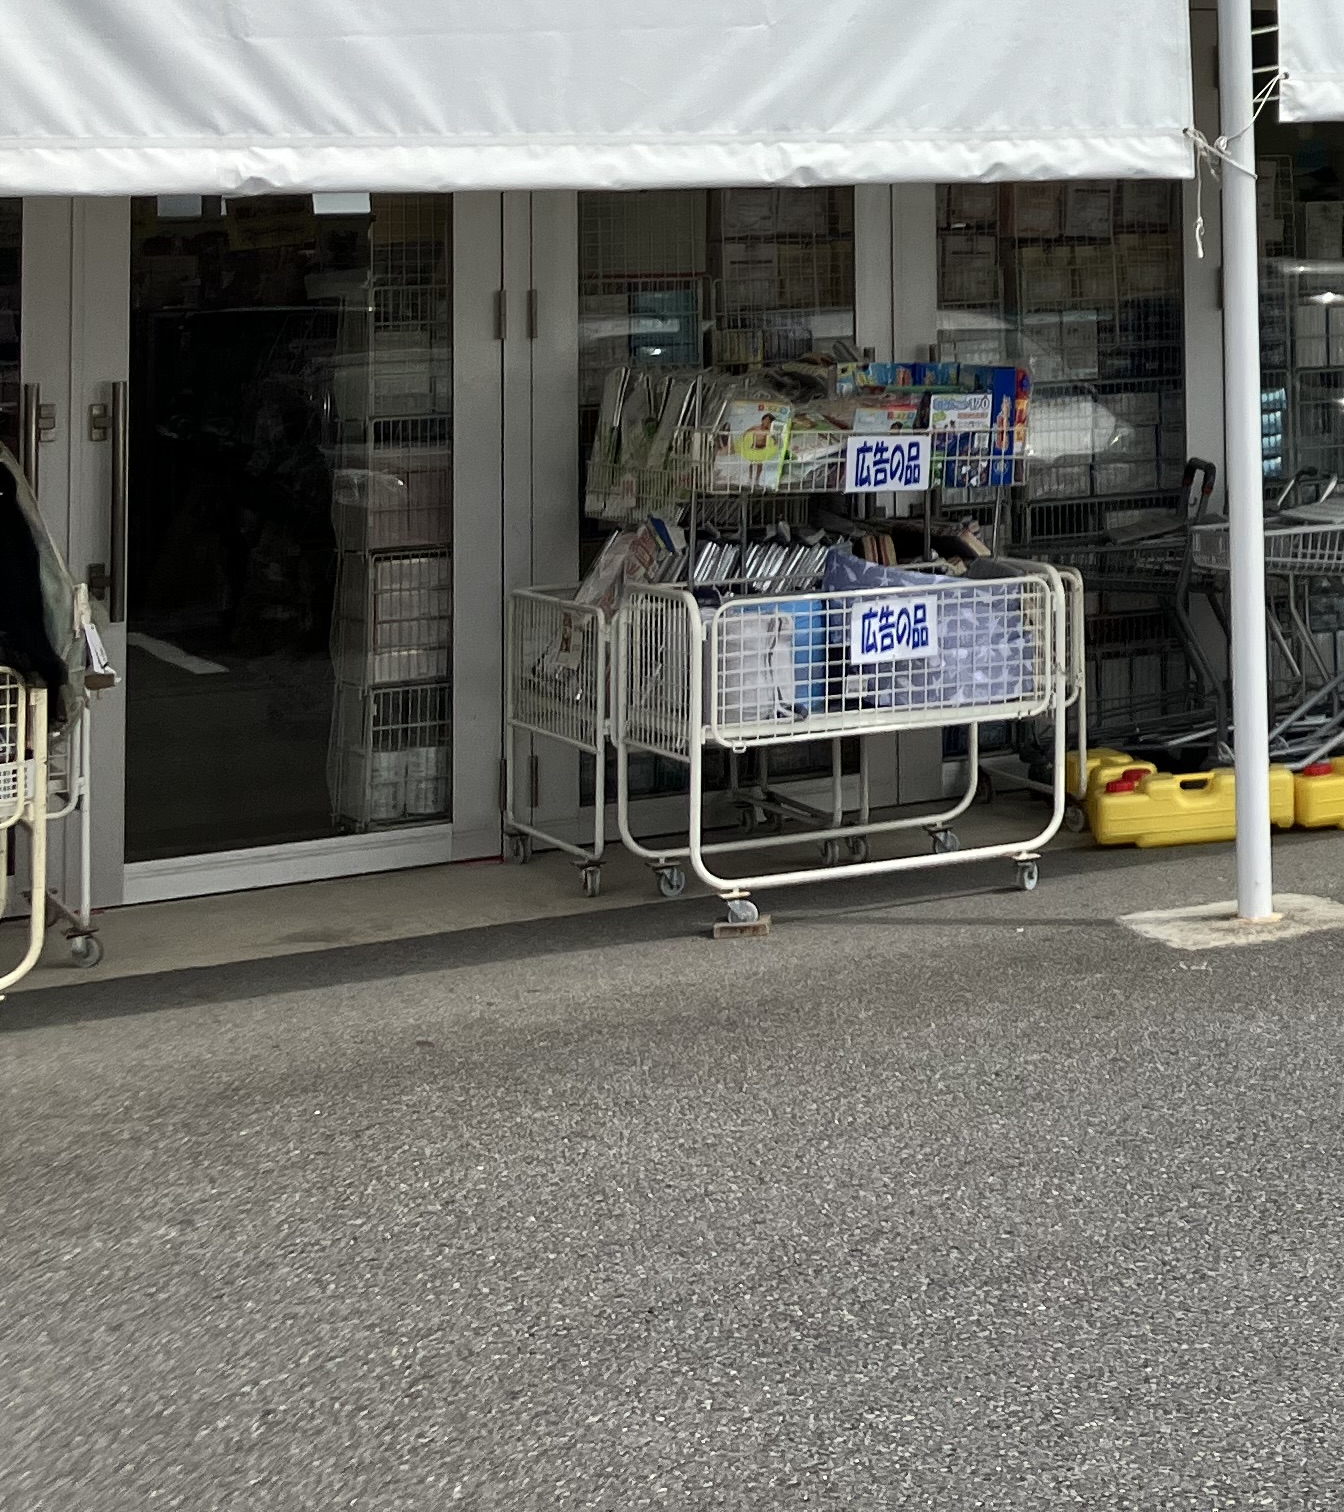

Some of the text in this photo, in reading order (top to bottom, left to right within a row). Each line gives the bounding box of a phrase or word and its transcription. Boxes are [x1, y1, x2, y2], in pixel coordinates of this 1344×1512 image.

[855, 441, 921, 488] 広告の品
[861, 603, 929, 655] 広告の品
